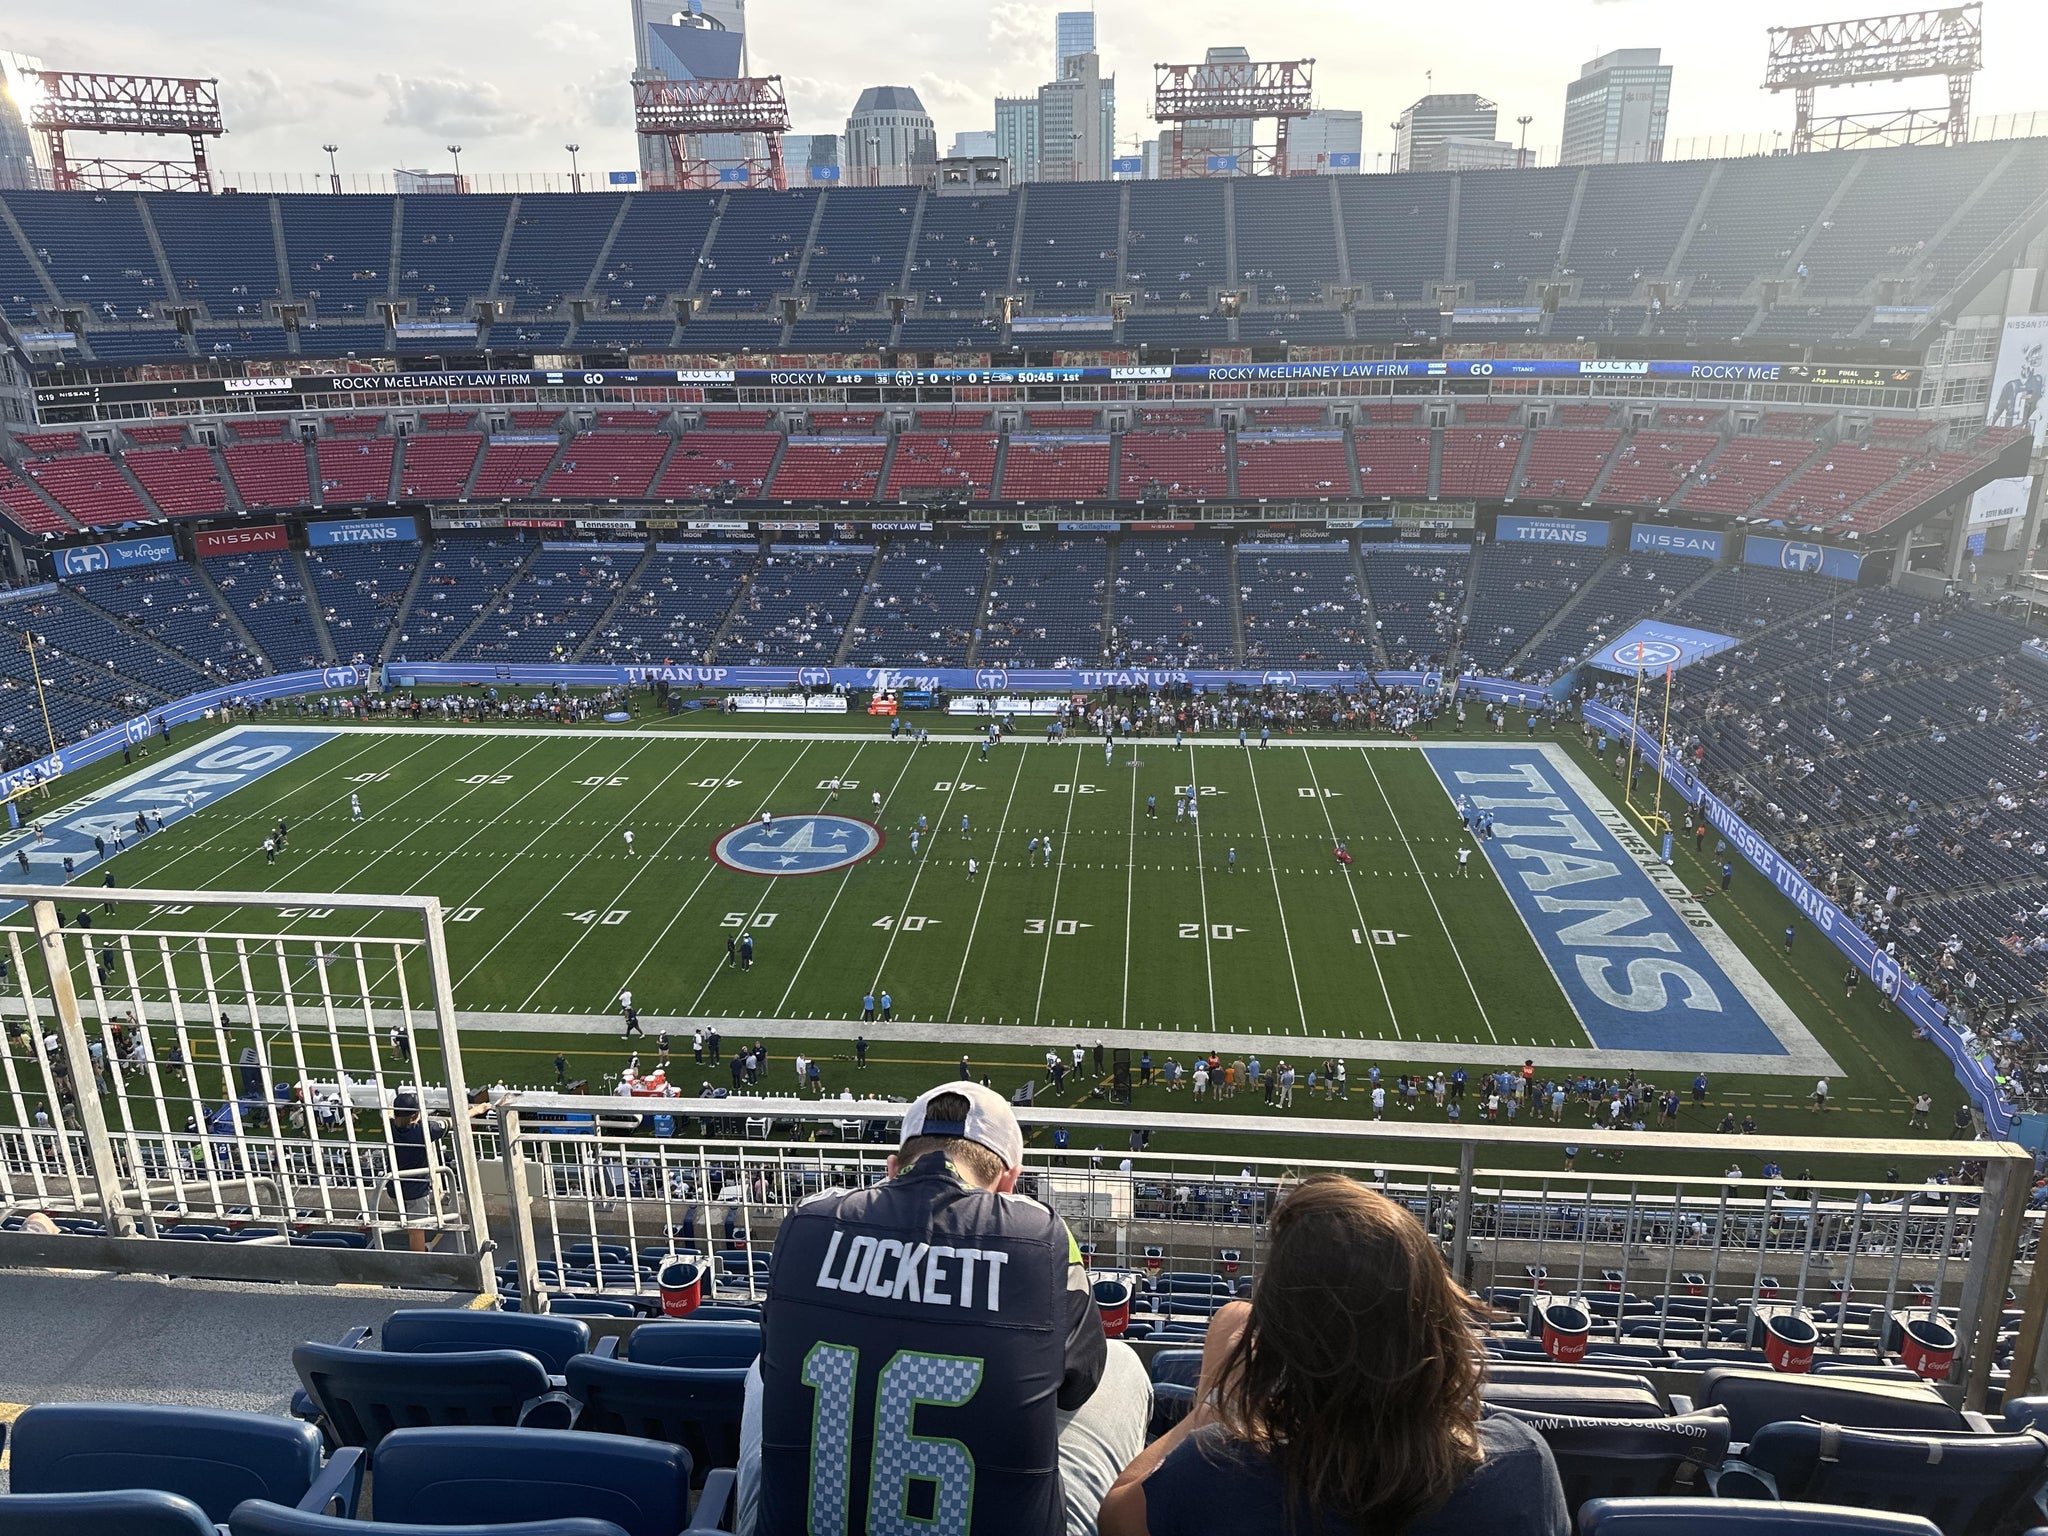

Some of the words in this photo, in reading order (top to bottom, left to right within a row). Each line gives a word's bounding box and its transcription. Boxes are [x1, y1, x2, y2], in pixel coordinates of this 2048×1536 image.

[2007, 321, 2037, 329] NISSAN
[1115, 367, 1167, 375] ROCKY
[1470, 364, 1493, 375] GO
[1585, 361, 1643, 370] ROCKY
[682, 370, 731, 378] ROCKY
[1018, 372, 1054, 382] 50:45
[1063, 373, 1080, 381] 1st
[1209, 368, 1254, 379] ROCKY
[1258, 366, 1339, 378] McELHANEY
[1343, 365, 1373, 377] LAW
[1377, 364, 1409, 376] FIRM
[1691, 366, 1744, 379] ROCKY
[1748, 367, 1780, 380] McE
[1816, 368, 1826, 376] 13
[230, 378, 287, 387] ROCKY
[333, 377, 380, 389] ROCKY
[384, 375, 464, 388] McELHANEY
[468, 374, 496, 386] LAW
[500, 374, 530, 385] FIRM
[584, 373, 604, 384] GO
[771, 373, 814, 384] ROCKY
[836, 375, 852, 383] 1st
[854, 375, 863, 383] &
[877, 376, 888, 384] 35
[930, 373, 939, 384] 0
[969, 373, 977, 383] 0
[38, 394, 55, 402] 6:19
[1078, 523, 1111, 531] Gallagher
[1529, 521, 1576, 529] TENNESSEE
[208, 531, 276, 545] NISSAN
[329, 528, 398, 542] TITANS
[1517, 527, 1587, 542] TITANS
[1637, 533, 1715, 551] NISSAN
[134, 543, 171, 561] Kroger
[1645, 631, 1714, 648] NISSAN
[624, 667, 696, 681] TITAN
[697, 668, 728, 681] UP
[1602, 664, 1634, 677] NISSAN
[1079, 672, 1150, 685] TITAN
[1154, 672, 1188, 685] UP
[463, 774, 515, 784] 20
[580, 776, 630, 787] 30
[697, 778, 744, 788] 40
[815, 779, 860, 790] 50
[933, 781, 977, 792] 40
[1053, 783, 1096, 794] 30
[1298, 787, 1333, 798] 10
[41, 796, 101, 821] LOVE
[1697, 786, 1774, 874] TENNESSEE
[1776, 860, 1835, 931] TITANS
[1595, 808, 1619, 826] IT
[1612, 818, 1651, 857] TAKES
[1641, 857, 1667, 883] ALL
[1661, 885, 1691, 907] OF
[1682, 909, 1713, 928] US
[1454, 764, 1723, 1013] TITANS
[571, 909, 632, 925] 40
[720, 912, 779, 928] 50
[871, 915, 929, 931] 40
[1023, 919, 1079, 935] 30
[1178, 923, 1234, 940] 20
[1351, 928, 1397, 946] 10
[816, 1230, 1009, 1312] LOCKETT
[666, 1299, 688, 1308] Coca-Cola
[1560, 1344, 1584, 1353] Coca-Cola
[1928, 1361, 1951, 1370] Coca-Cola
[801, 1340, 985, 1536] 16
